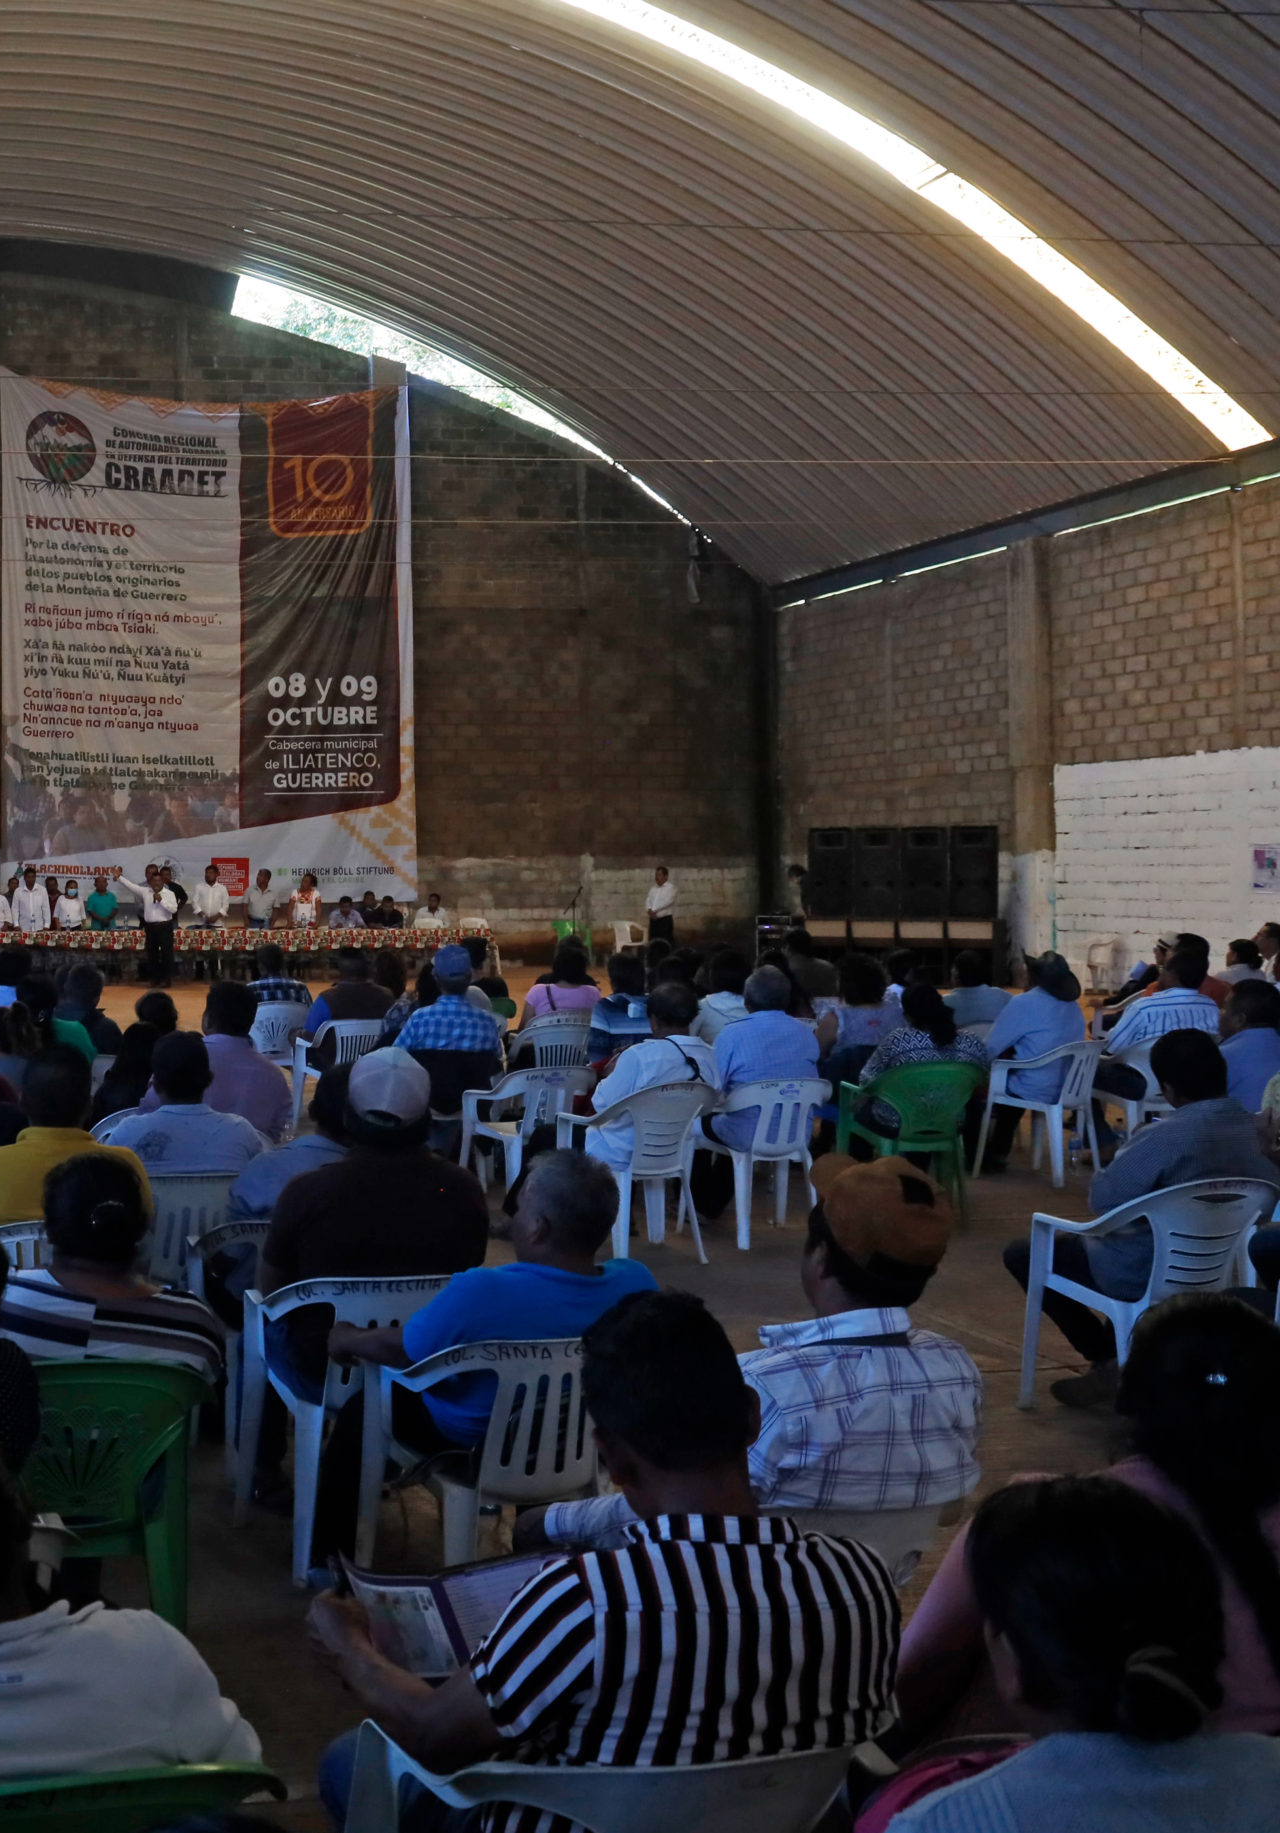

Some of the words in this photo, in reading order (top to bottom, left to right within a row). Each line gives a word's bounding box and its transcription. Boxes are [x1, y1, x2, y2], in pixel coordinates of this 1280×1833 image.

[105, 439, 117, 448] DE
[118, 440, 180, 454] AUTORIDADES
[164, 435, 218, 448] REGIONAL
[118, 454, 155, 464] DEFENSA
[157, 456, 173, 465] DEL
[175, 457, 228, 467] TERRITORIO
[283, 453, 354, 502] 10
[25, 515, 136, 538] ENCUENTRO
[25, 538, 44, 549] Por
[46, 539, 58, 550] la
[61, 540, 110, 555] defensa
[112, 545, 129, 556] de
[39, 554, 104, 569] autonomía
[105, 560, 113, 571] y
[129, 561, 185, 575] territorio
[25, 566, 40, 577] de
[41, 568, 60, 579] los
[62, 570, 113, 585] pueblos
[115, 574, 181, 589] originarios
[25, 581, 40, 592] de
[41, 583, 53, 593] la
[56, 583, 110, 597] Montaña
[113, 587, 129, 599] de
[130, 589, 188, 602] Guerrero
[84, 606, 114, 621] jumo
[115, 660, 131, 669] na
[50, 666, 79, 679] Yuku
[117, 668, 143, 682] Ñuu
[267, 672, 307, 698] 08
[314, 677, 333, 704] y
[340, 675, 378, 701] 09
[70, 705, 85, 714] na
[144, 706, 163, 720] jaa
[267, 705, 378, 726] OCTUBRE
[85, 718, 101, 728] na
[22, 726, 75, 739] Guerrero
[268, 739, 322, 750] Cabecera
[323, 738, 378, 751] municipal
[264, 759, 280, 769] de
[283, 752, 381, 770] ILIATENCO,
[273, 772, 373, 788] GUERRERO
[292, 867, 330, 876] HEINRICH
[333, 865, 354, 875] BÖLL
[356, 866, 395, 875] STIFTUNG
[332, 1280, 381, 1296] SANTA
[386, 1278, 441, 1293] CECILIA
[480, 1343, 552, 1361] SANTA
